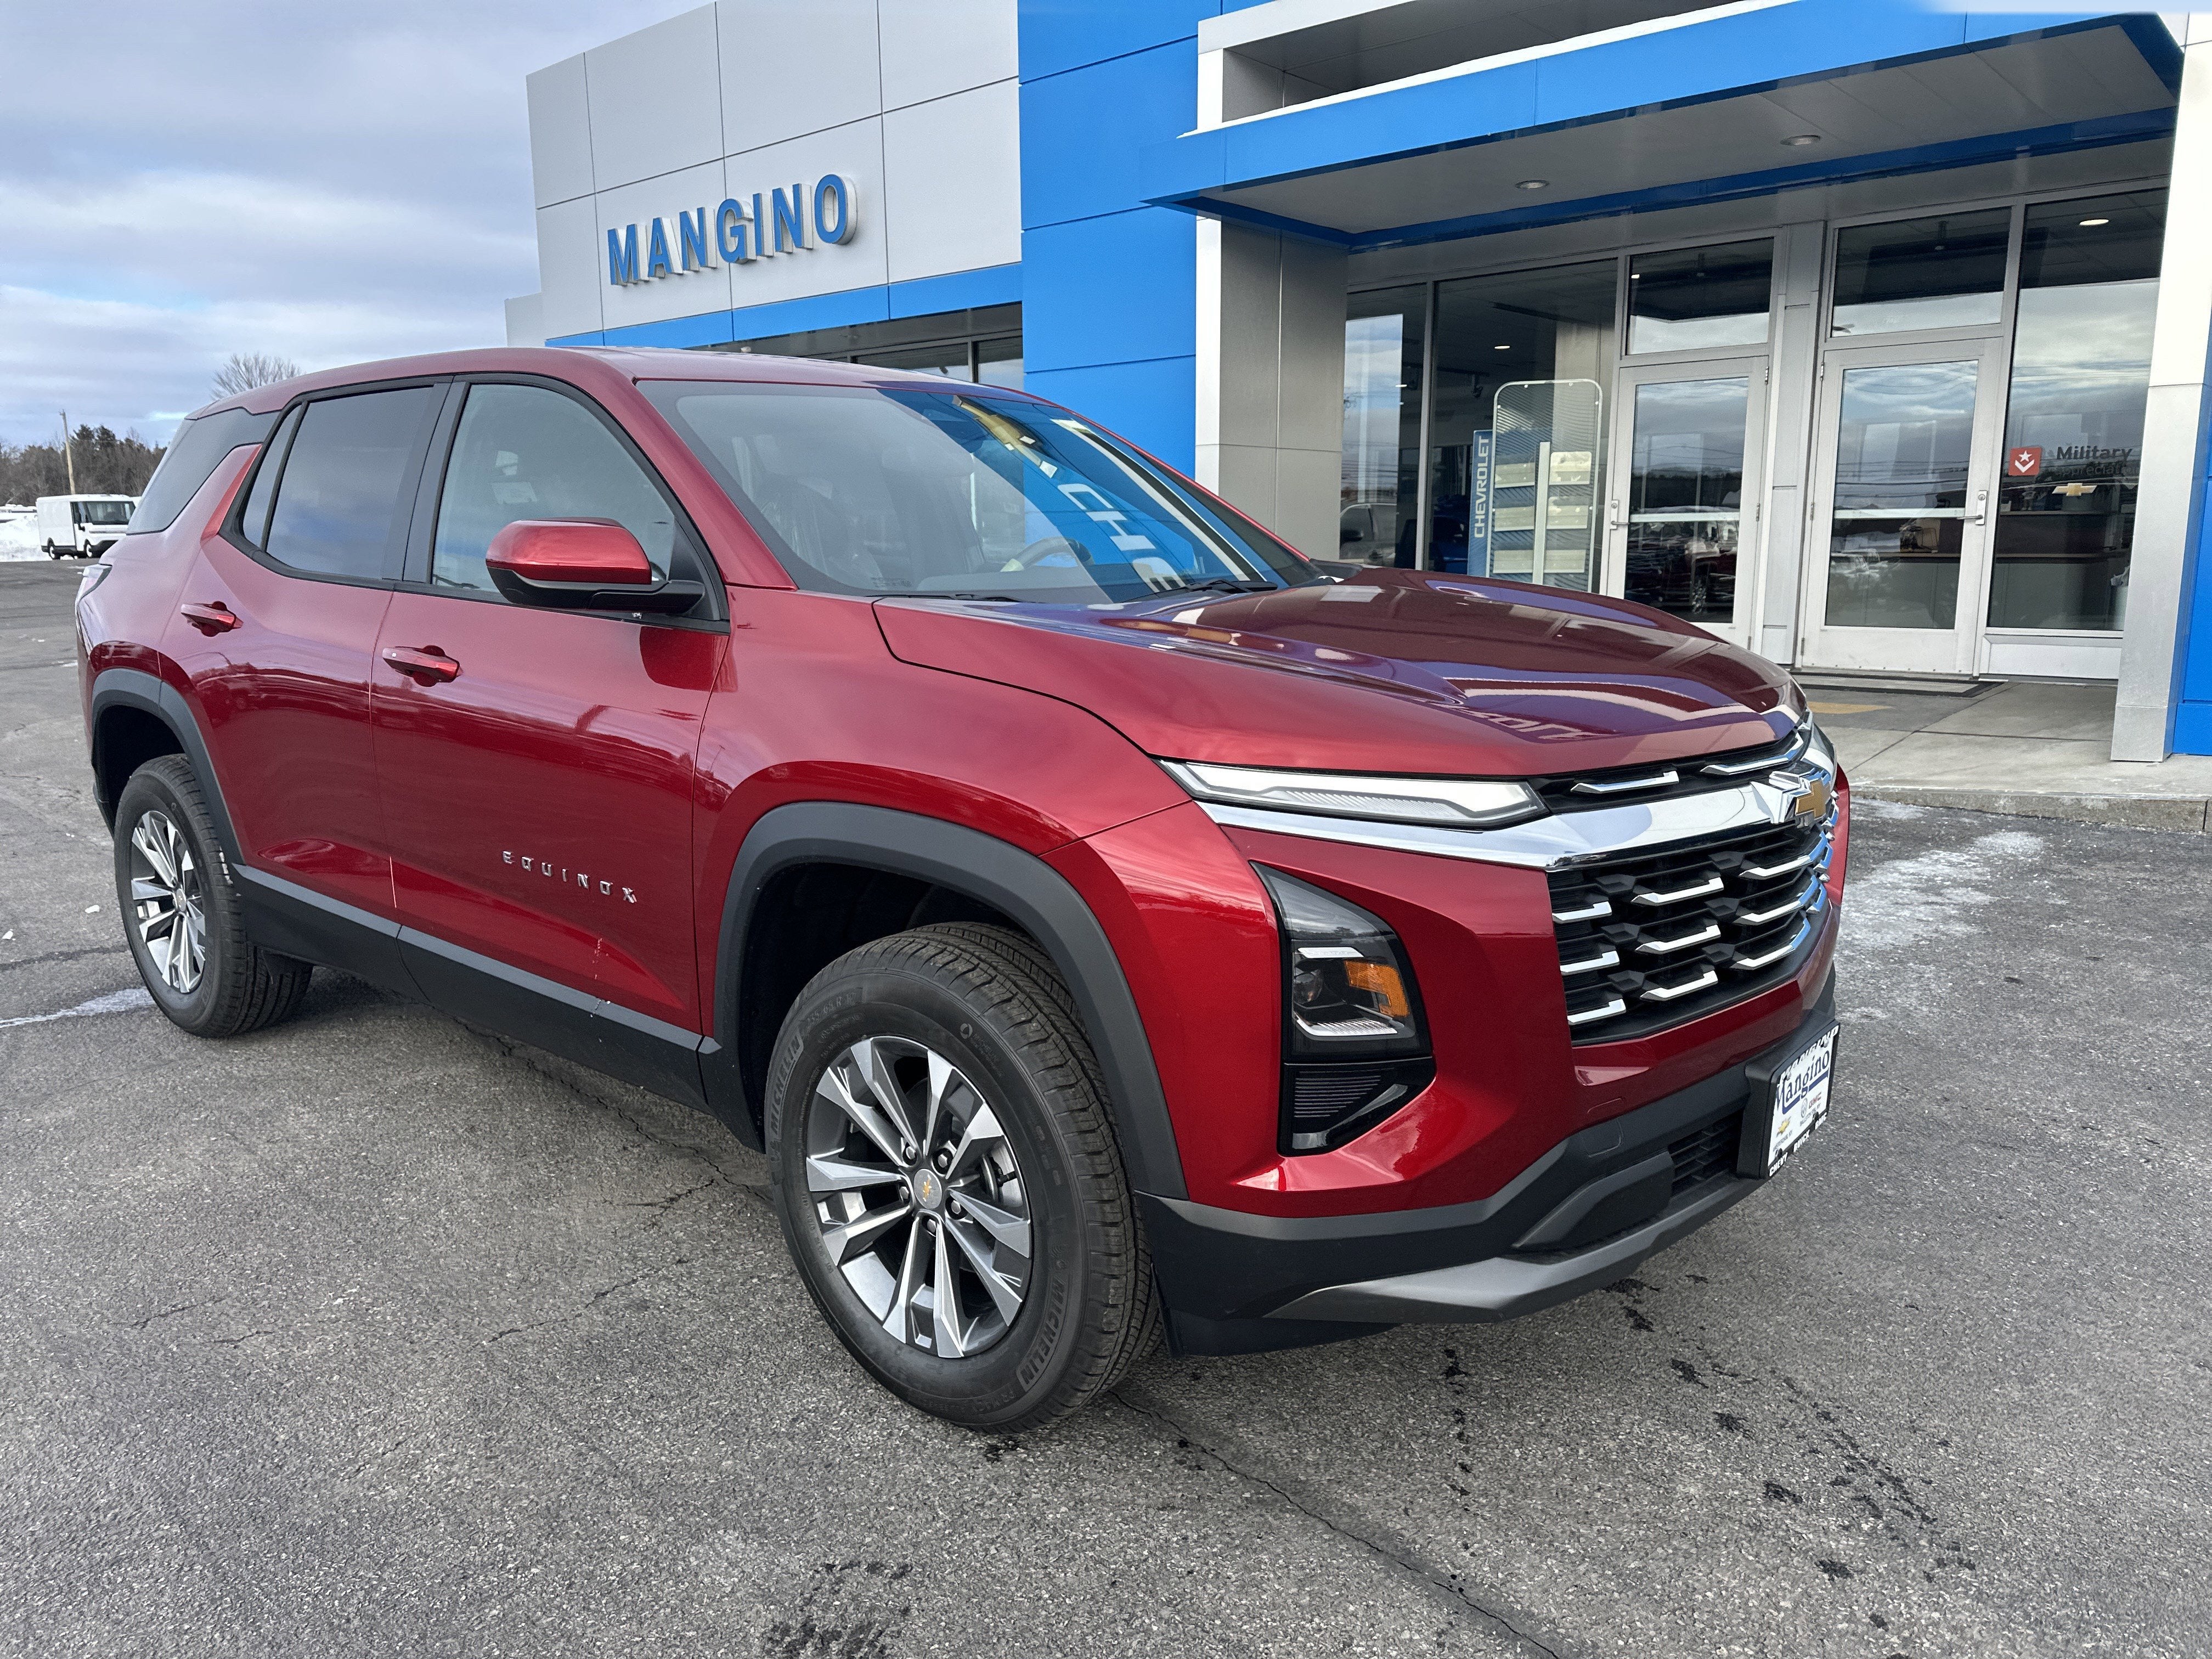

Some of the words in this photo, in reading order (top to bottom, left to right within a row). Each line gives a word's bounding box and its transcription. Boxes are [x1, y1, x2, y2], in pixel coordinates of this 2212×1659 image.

[607, 174, 854, 285] MANGINO
[2057, 445, 2132, 466] Military
[1474, 435, 1489, 538] CHEVROLET
[503, 850, 637, 904] EQUINOX
[770, 1034, 800, 1136] MICHELIN
[1776, 1050, 1830, 1114] Mangino
[1793, 1130, 1810, 1153] BUICK
[1815, 1112, 1827, 1130] GMC
[1769, 1152, 1788, 1177] CHEVY
[1019, 1274, 1066, 1386] MICHELIN
